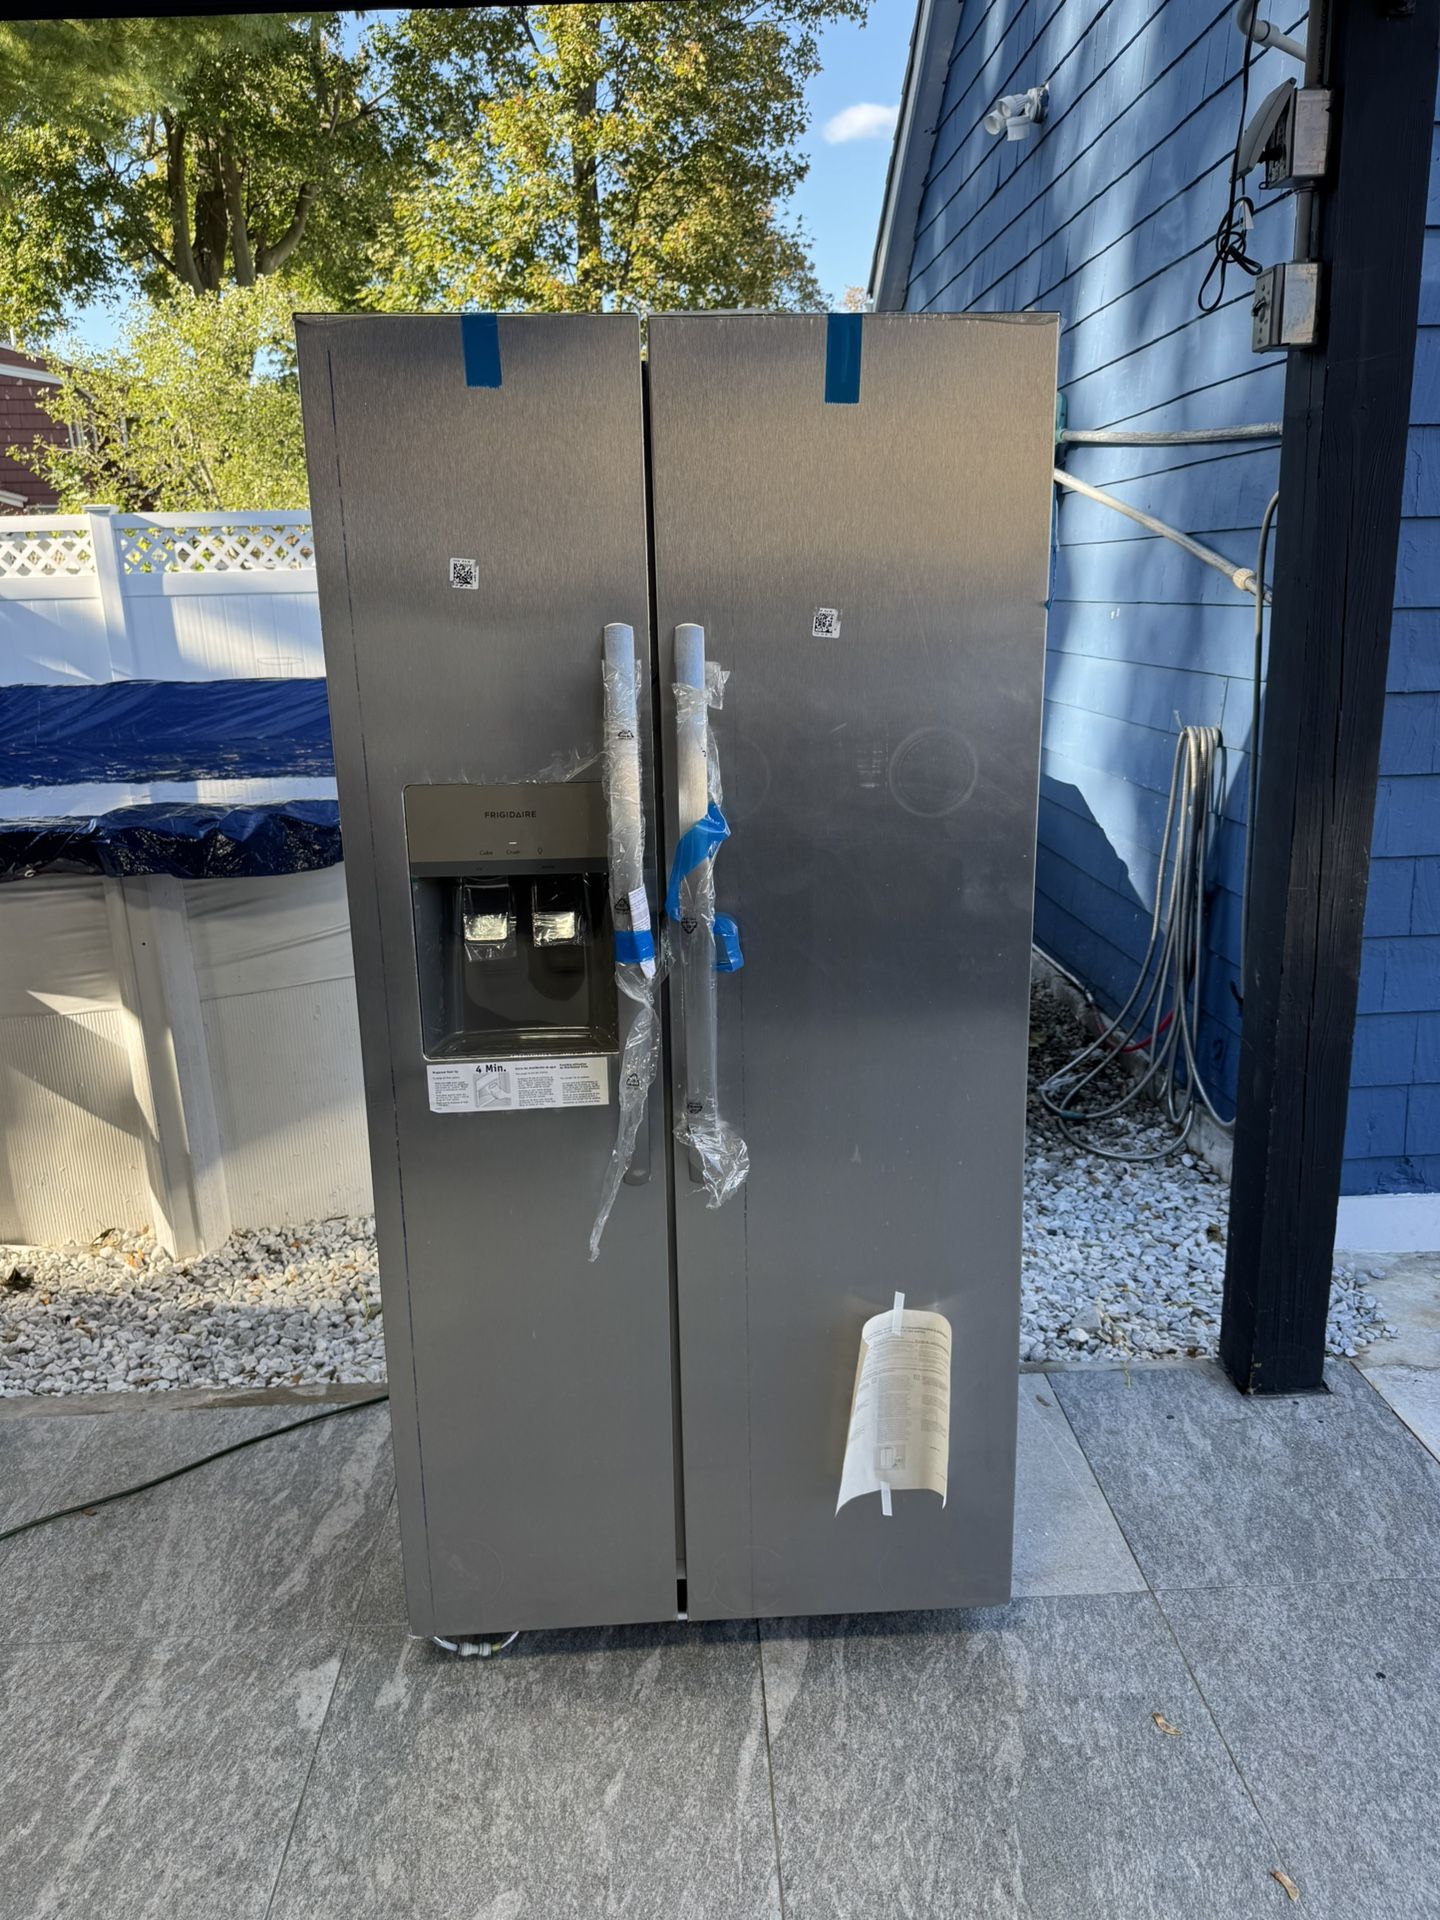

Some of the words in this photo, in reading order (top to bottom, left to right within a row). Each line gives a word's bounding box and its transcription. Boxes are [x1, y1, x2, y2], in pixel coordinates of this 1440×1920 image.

[484, 810, 537, 818] FRIGIDAIRE
[475, 1065, 482, 1073] 4
[485, 1063, 507, 1073] Min.
